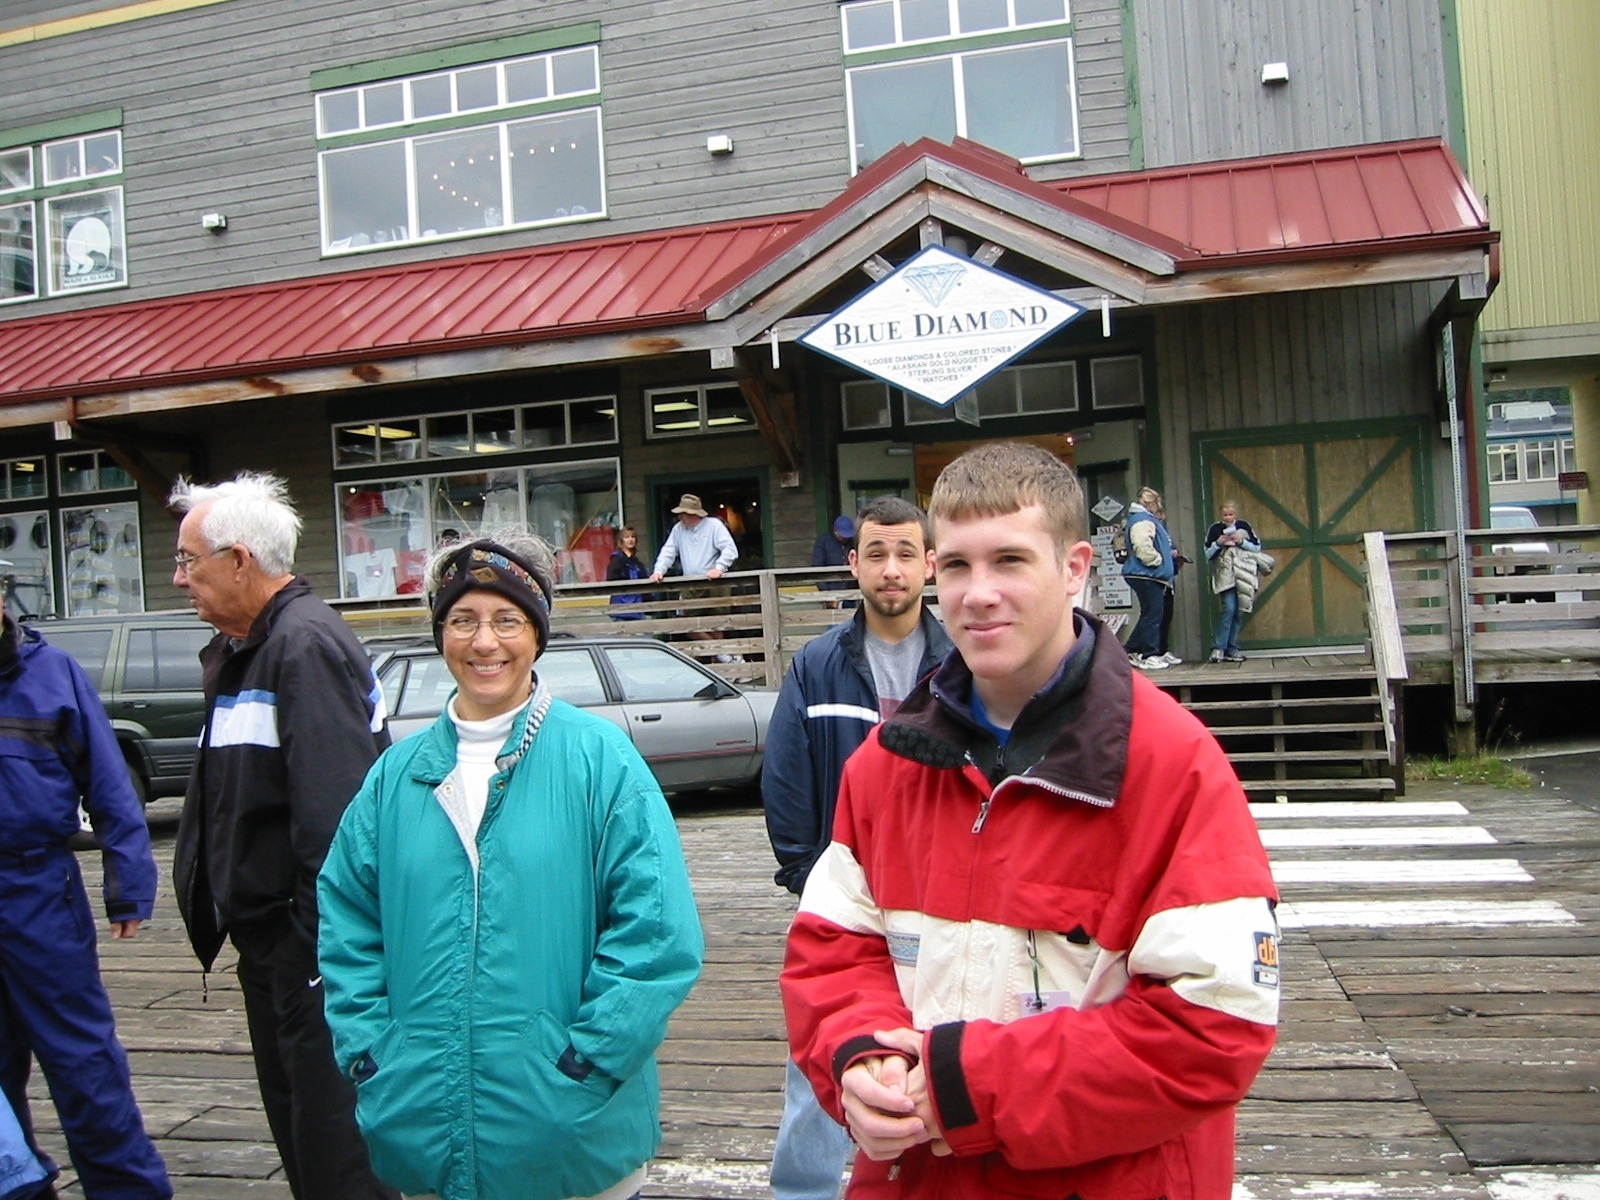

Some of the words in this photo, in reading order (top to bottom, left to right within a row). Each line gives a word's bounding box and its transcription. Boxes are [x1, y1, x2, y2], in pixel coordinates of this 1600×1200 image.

[834, 321, 903, 346] BLUE
[914, 305, 1048, 338] DIAMOND
[868, 356, 893, 366] LOOSE
[895, 352, 934, 362] DIAMONDS
[943, 348, 980, 358] COLORED
[981, 345, 1012, 355] STONES
[892, 361, 928, 370] ALASKAN
[929, 359, 950, 368] GOLD
[952, 355, 988, 364] NUGGETS
[908, 367, 945, 377] STERLING
[946, 364, 973, 374] SILVER
[923, 374, 959, 383] WATCHES
